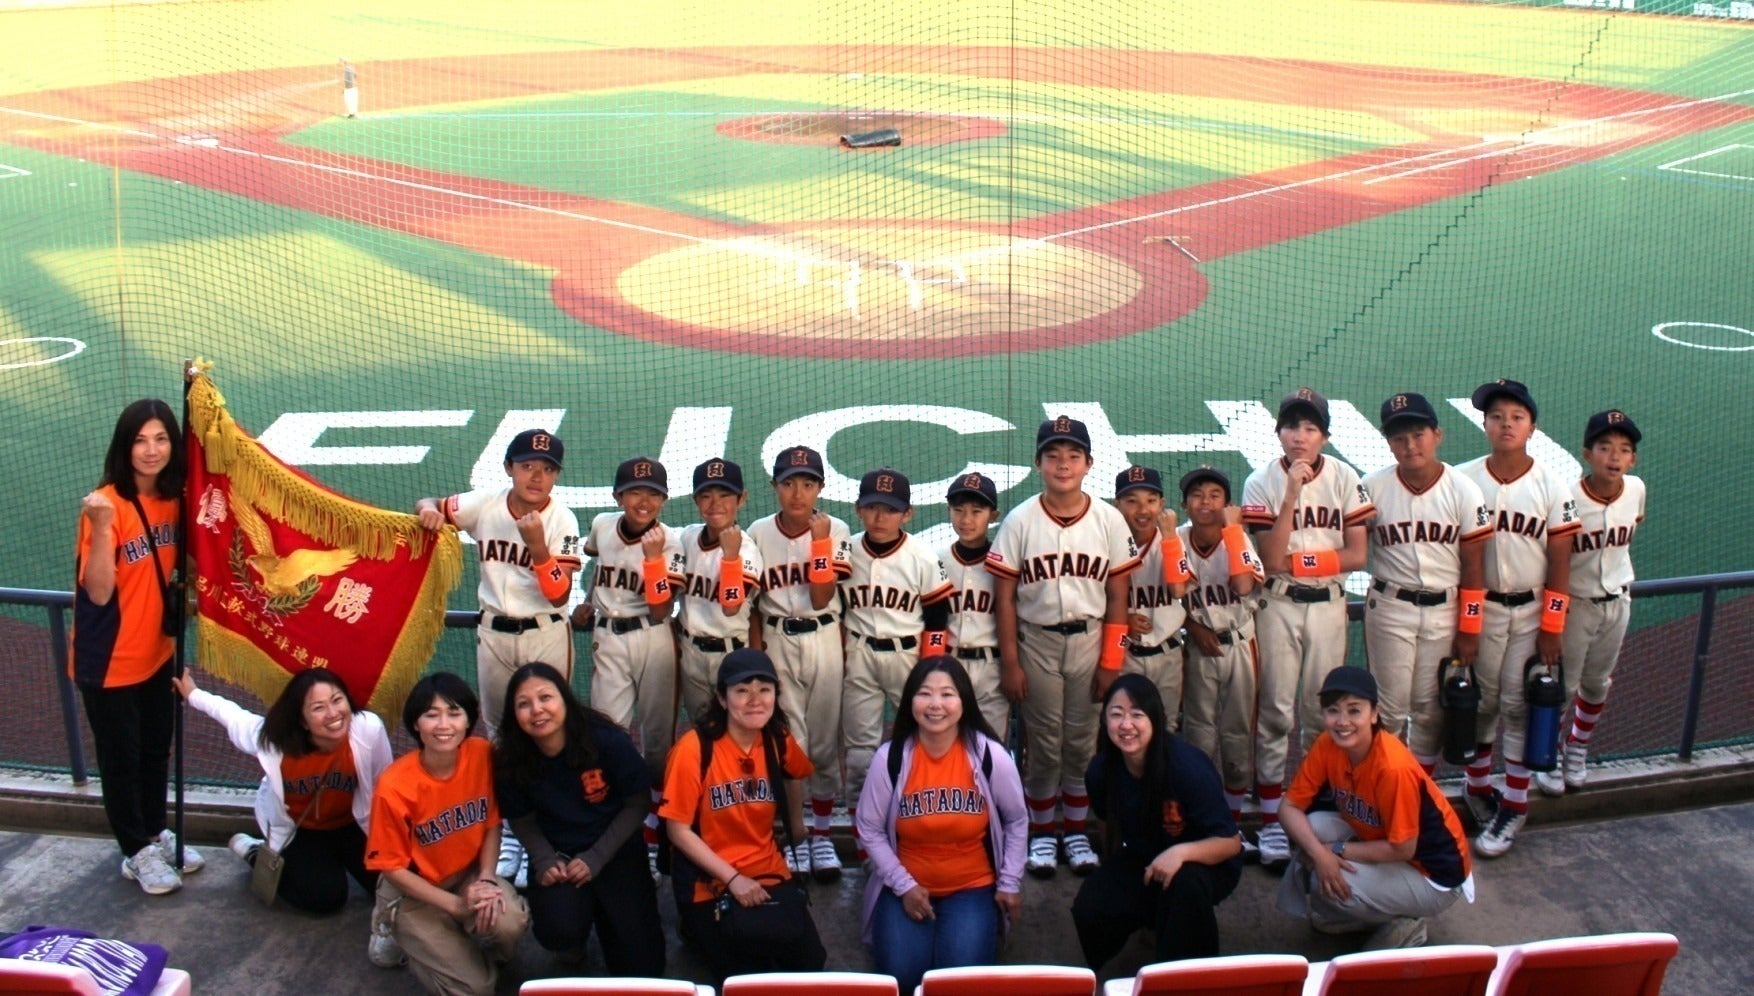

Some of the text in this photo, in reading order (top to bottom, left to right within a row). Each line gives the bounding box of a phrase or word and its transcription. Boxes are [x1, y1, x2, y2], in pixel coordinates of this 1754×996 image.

[1377, 521, 1461, 547] HATADAI
[1021, 552, 1110, 584] HATADAI
[323, 577, 373, 624] 勝
[849, 585, 919, 613] ATADAI
[899, 786, 986, 819] HATADAI
